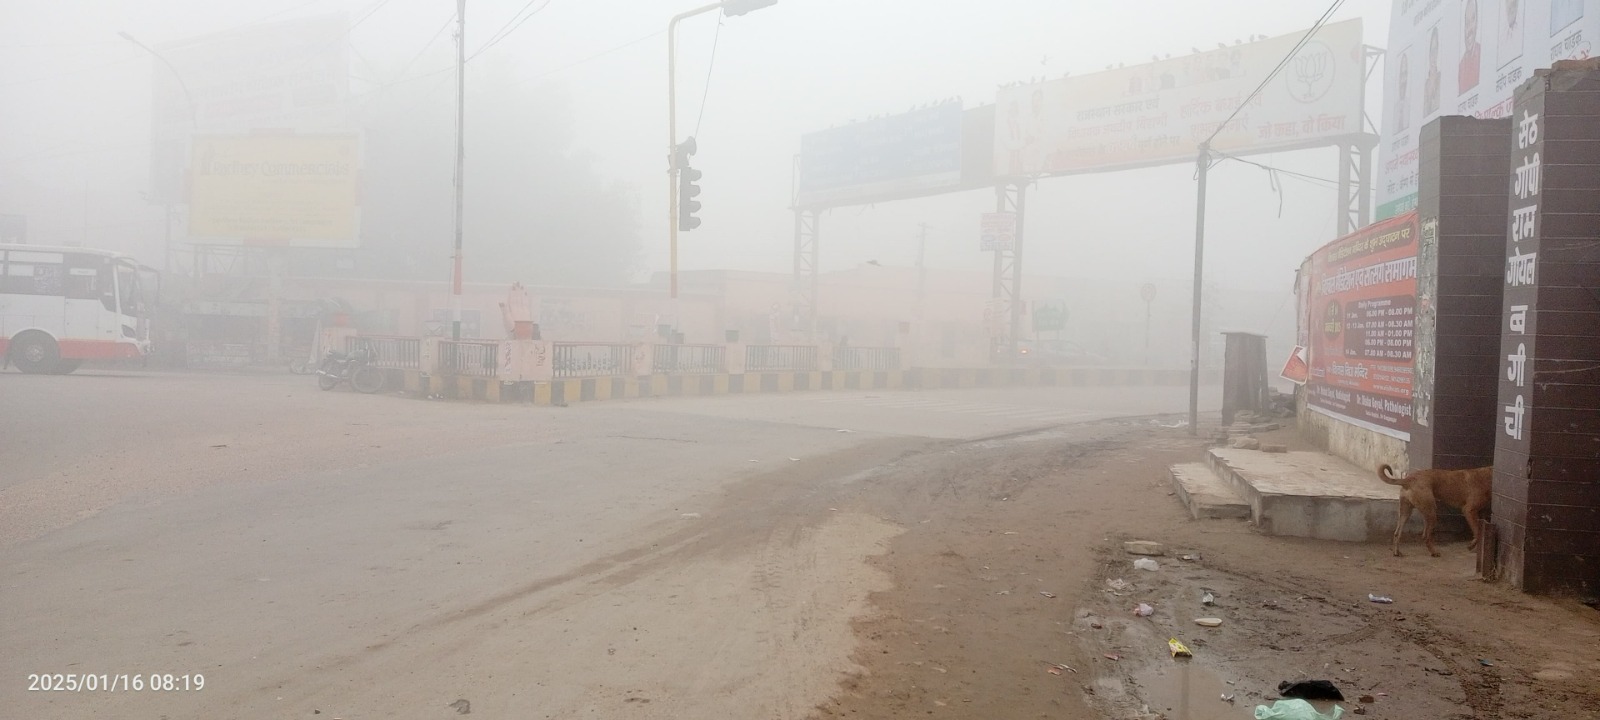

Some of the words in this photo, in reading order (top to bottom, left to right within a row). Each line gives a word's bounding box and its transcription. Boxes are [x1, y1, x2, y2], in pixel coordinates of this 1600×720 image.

[1113, 100, 1143, 116] सरकार
[1180, 97, 1213, 119] हार्दिक
[1257, 121, 1273, 139] जो
[1274, 121, 1299, 138] कहा,
[1301, 115, 1316, 134] वो
[1317, 113, 1346, 132] किया
[1519, 109, 1538, 149] सेठ
[1515, 152, 1540, 200] गोपी
[1513, 204, 1537, 242] राम
[1401, 227, 1411, 240] पर
[1384, 256, 1418, 284] समागम
[1507, 246, 1537, 286] गोयल
[1368, 299, 1392, 309] Programme
[1403, 306, 1413, 316] PM
[1403, 319, 1413, 329] AM
[1388, 330, 1402, 338] 01.00
[1403, 329, 1413, 338] PM
[1402, 339, 1412, 348] PM
[1402, 351, 1412, 360] AM
[1384, 398, 1412, 418] Pathologist
